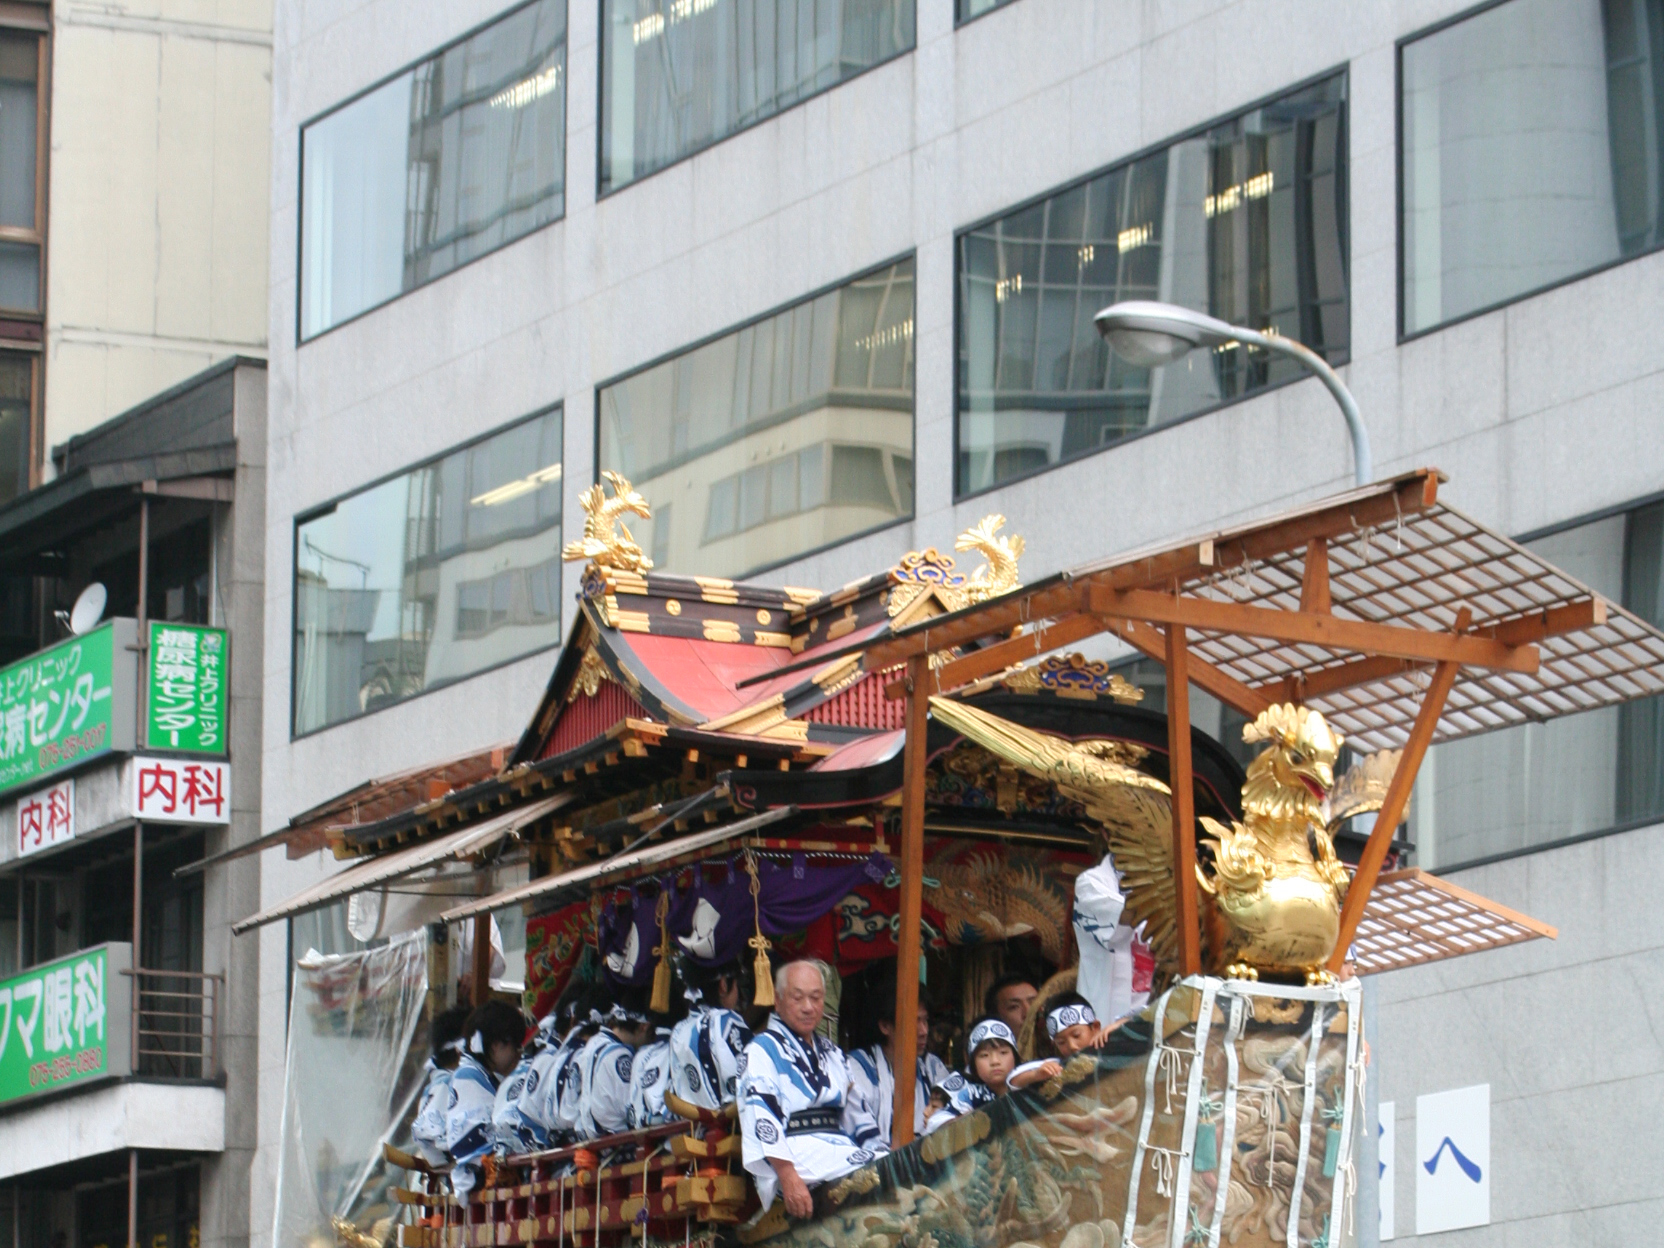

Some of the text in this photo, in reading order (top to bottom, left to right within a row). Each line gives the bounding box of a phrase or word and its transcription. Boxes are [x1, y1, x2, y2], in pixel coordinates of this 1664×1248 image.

[0, 644, 82, 704] 上クリニック
[155, 628, 198, 747] 糖尿病センター
[199, 654, 219, 746] 井上クリニック
[0, 672, 112, 760] 病センター
[20, 785, 72, 851] 内科
[138, 763, 225, 817] 内科
